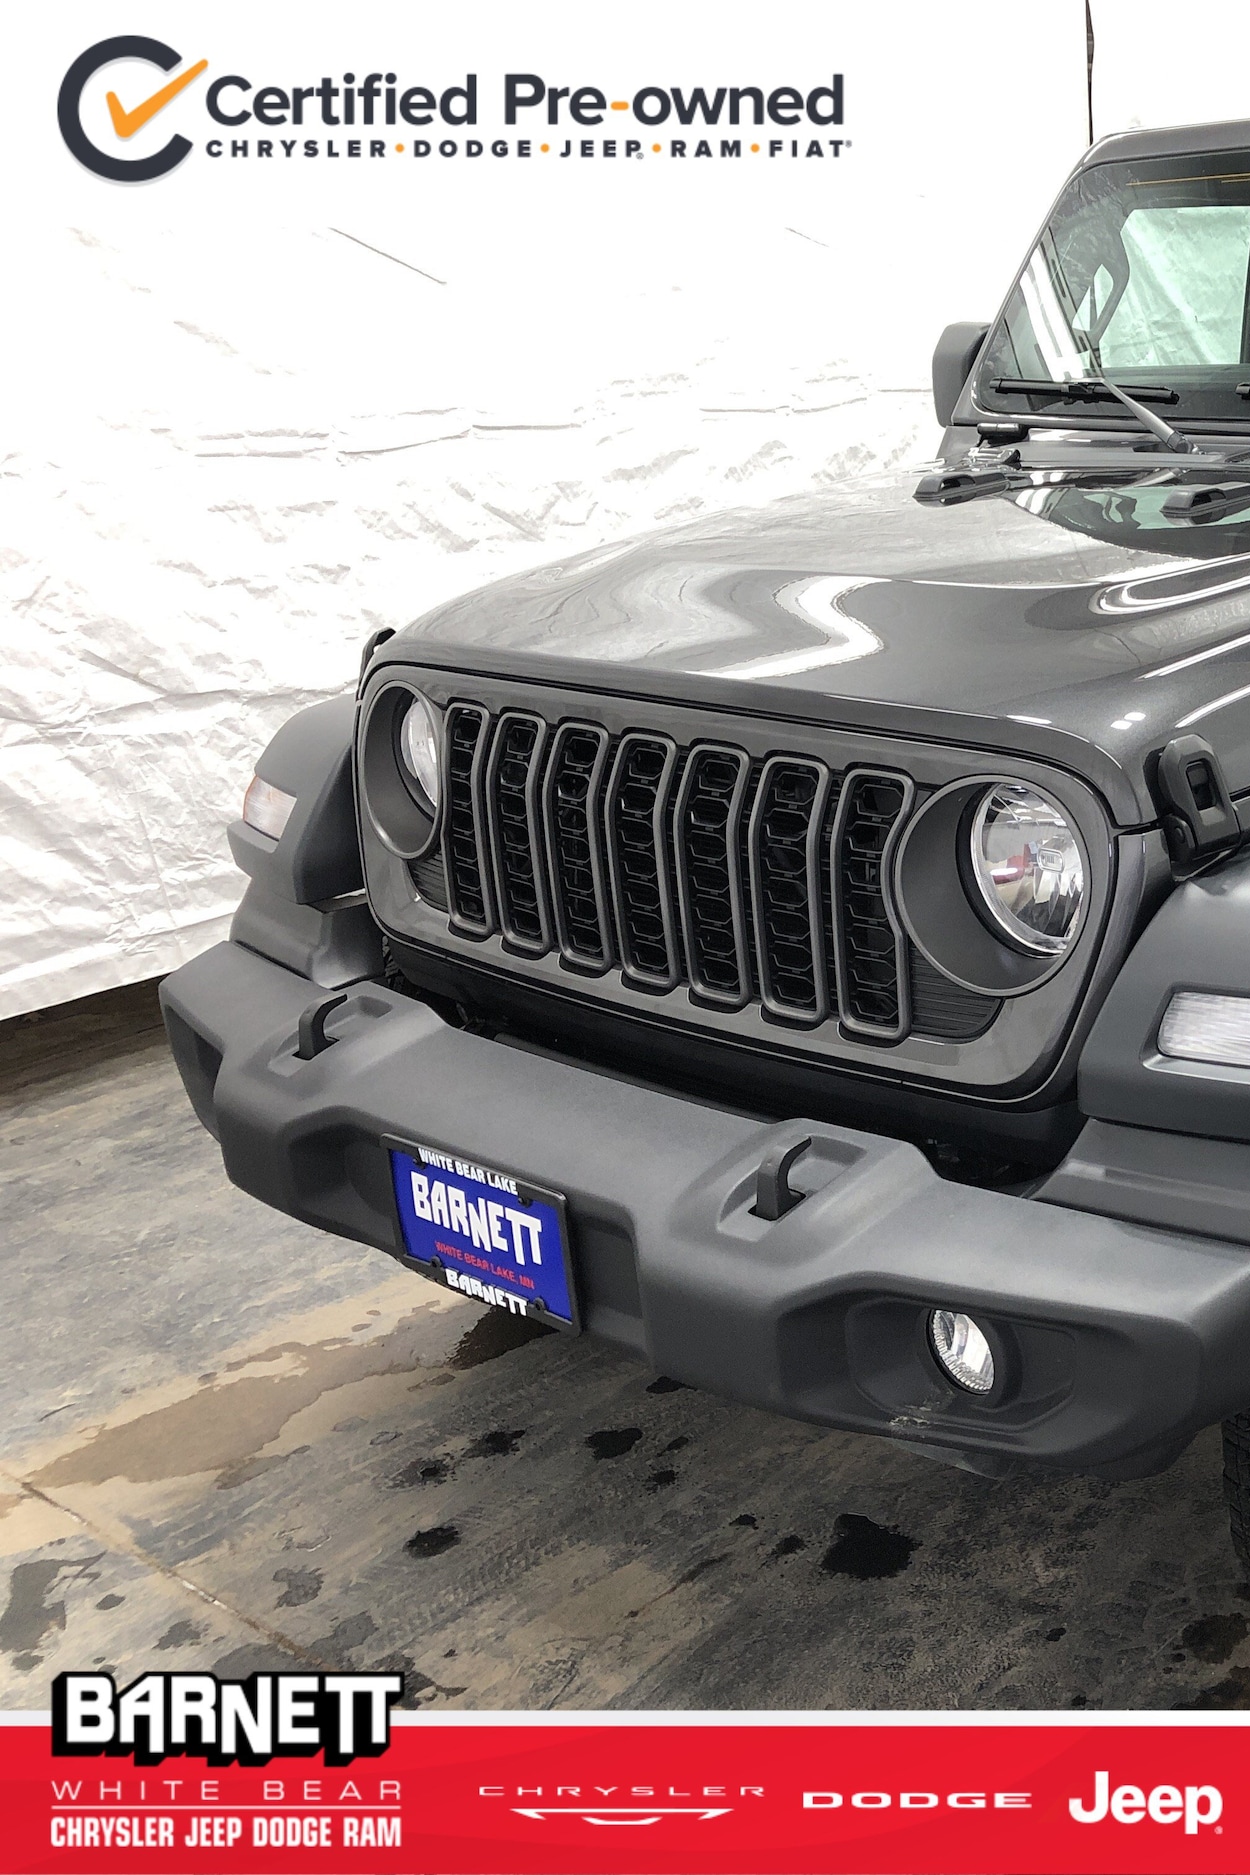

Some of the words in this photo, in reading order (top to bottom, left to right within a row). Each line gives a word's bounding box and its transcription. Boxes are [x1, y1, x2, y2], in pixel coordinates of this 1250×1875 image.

[418, 1147, 455, 1174] WHITE
[454, 1160, 486, 1185] BEAR
[487, 1171, 518, 1196] LAKE
[410, 1171, 543, 1266] BARNETT
[435, 1241, 463, 1260] WHITE
[464, 1252, 490, 1271] BEAR
[445, 1267, 528, 1317] BARNETT
